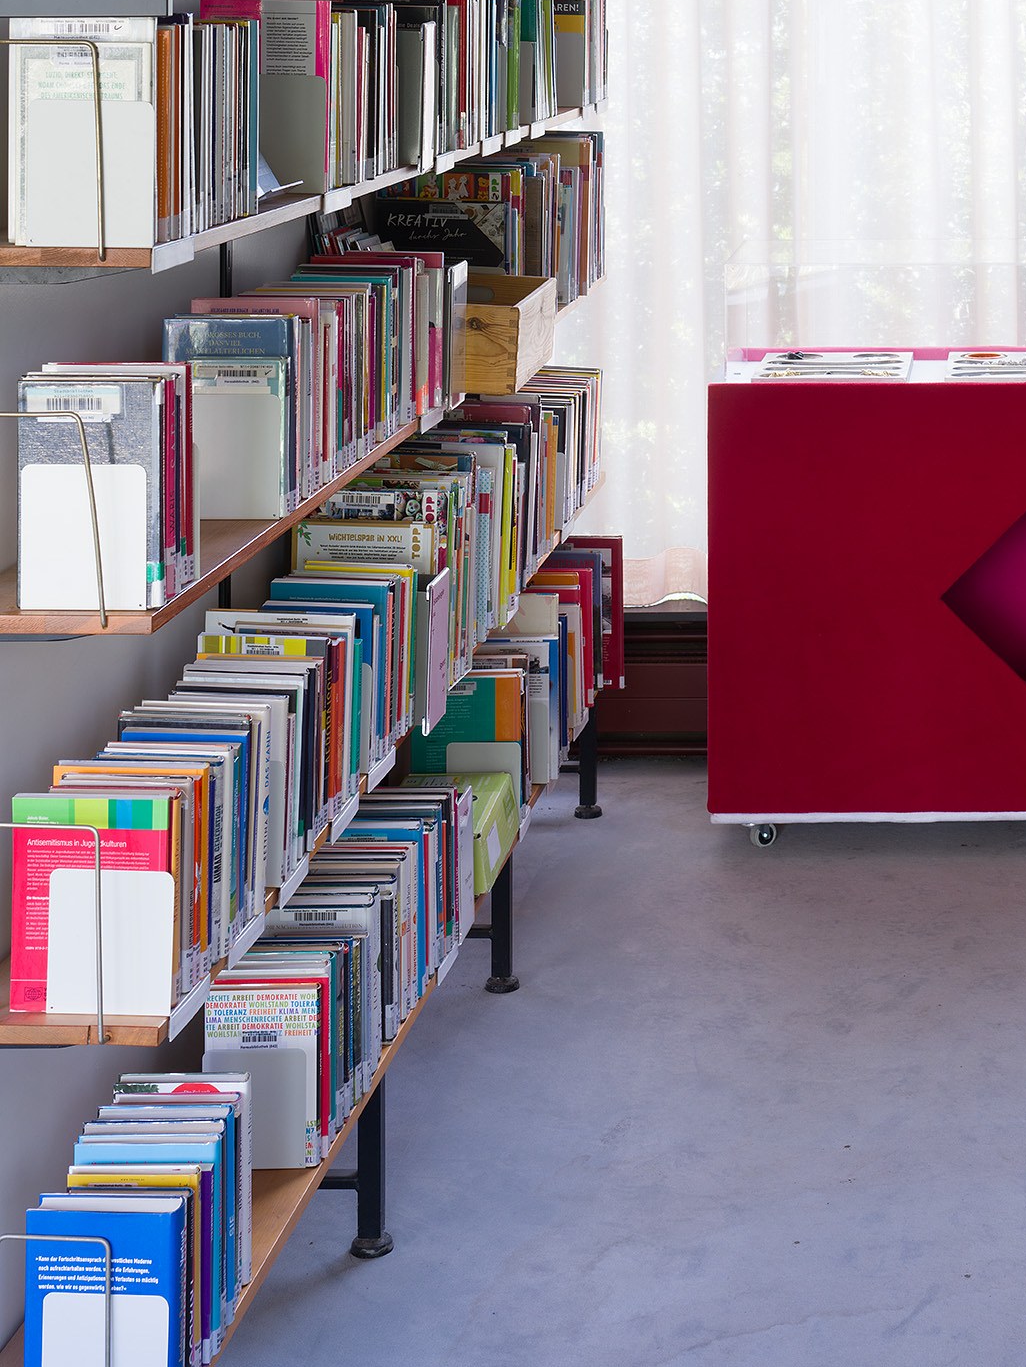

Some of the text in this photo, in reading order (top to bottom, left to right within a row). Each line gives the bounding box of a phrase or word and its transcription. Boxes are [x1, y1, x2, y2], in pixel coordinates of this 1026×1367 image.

[387, 213, 449, 228] KREATIV
[425, 496, 435, 523] OPP
[412, 527, 421, 560] TOPP
[27, 838, 80, 847] Antisemitismus in
[232, 994, 254, 1002] ARBEIT
[206, 1001, 247, 1009] DEMOKRATIE
[249, 1008, 277, 1016] FREIHEIT
[223, 1015, 283, 1023] MENSCHENRECHTE
[217, 1023, 240, 1031] ARBEIT
